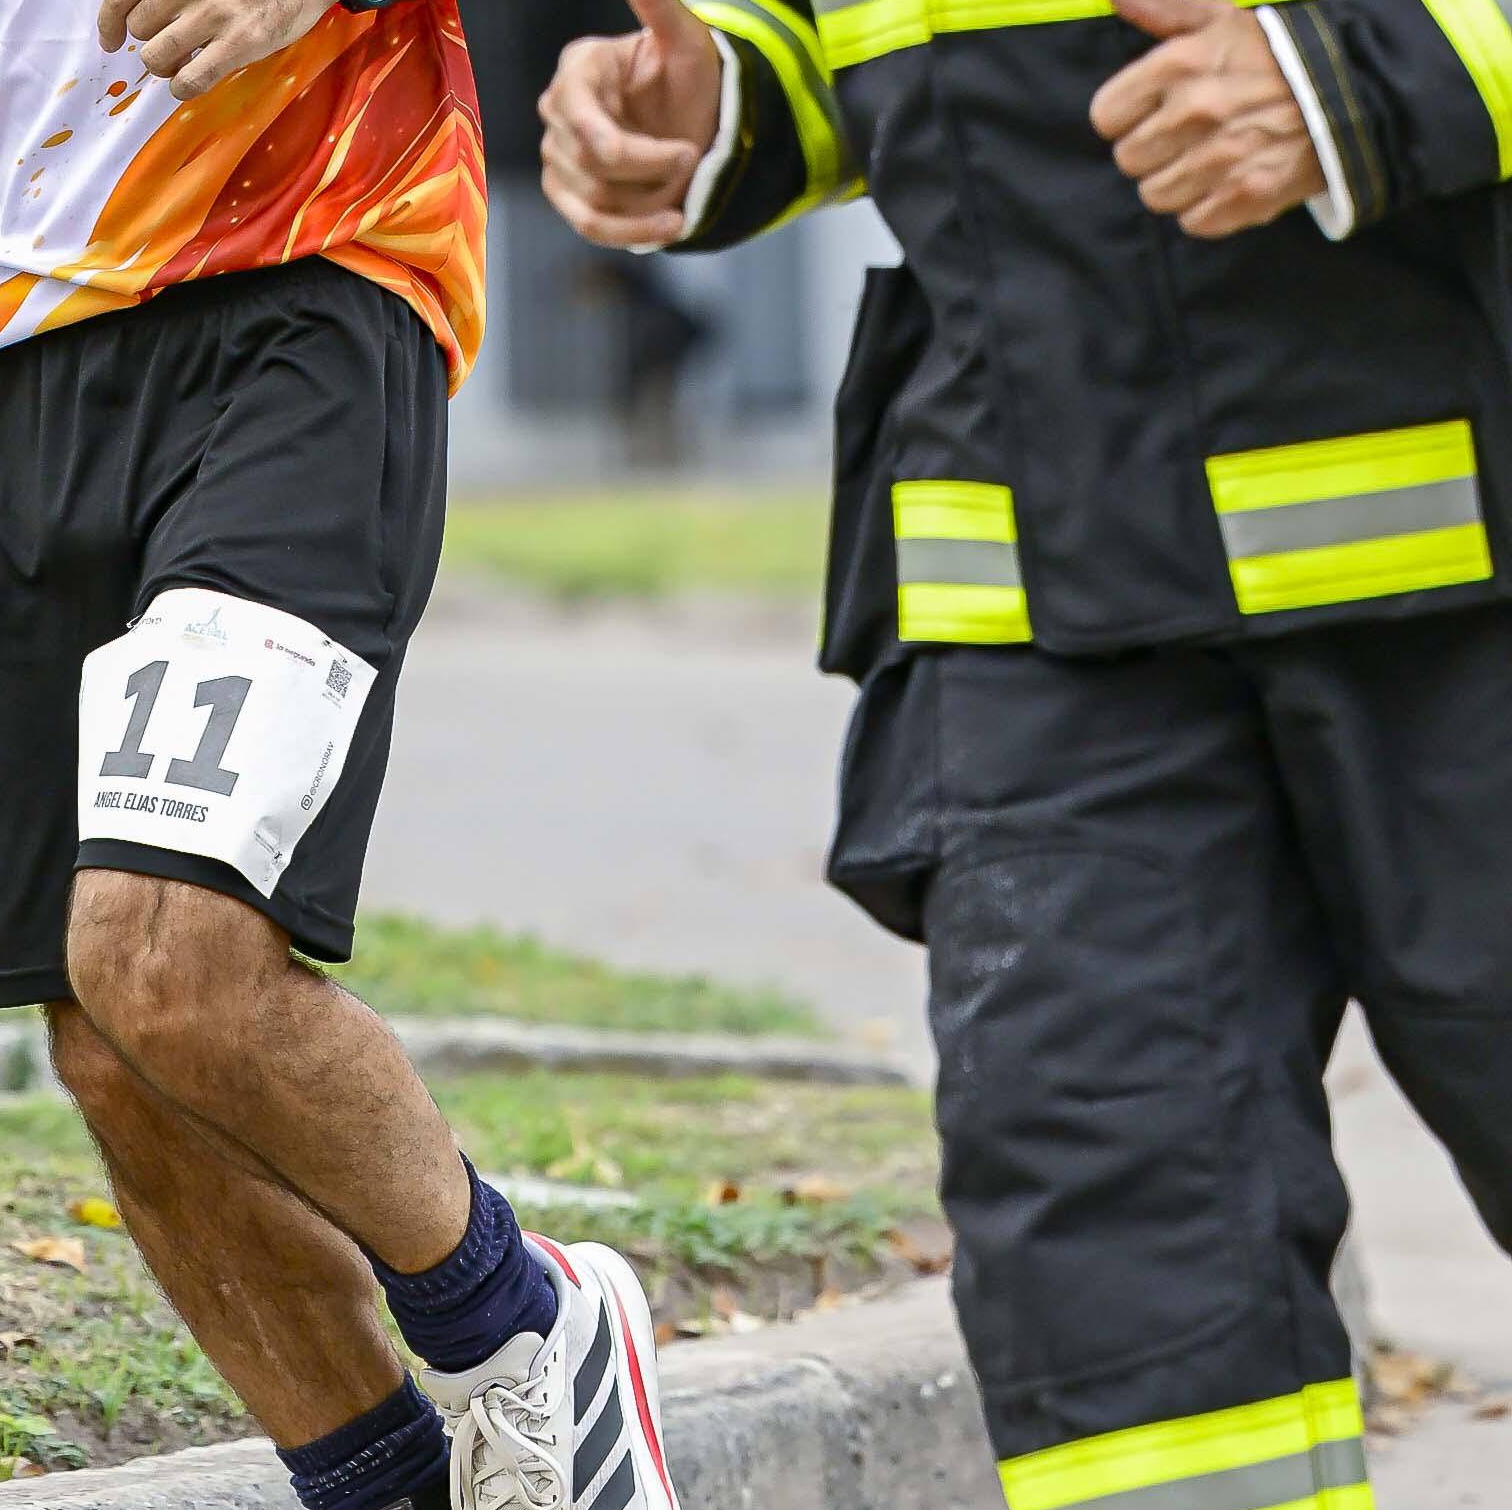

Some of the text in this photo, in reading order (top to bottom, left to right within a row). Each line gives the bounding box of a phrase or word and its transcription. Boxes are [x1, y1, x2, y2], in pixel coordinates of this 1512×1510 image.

[99, 660, 252, 797] 11
[93, 790, 209, 824] ANGEL ELIAS TORRES
